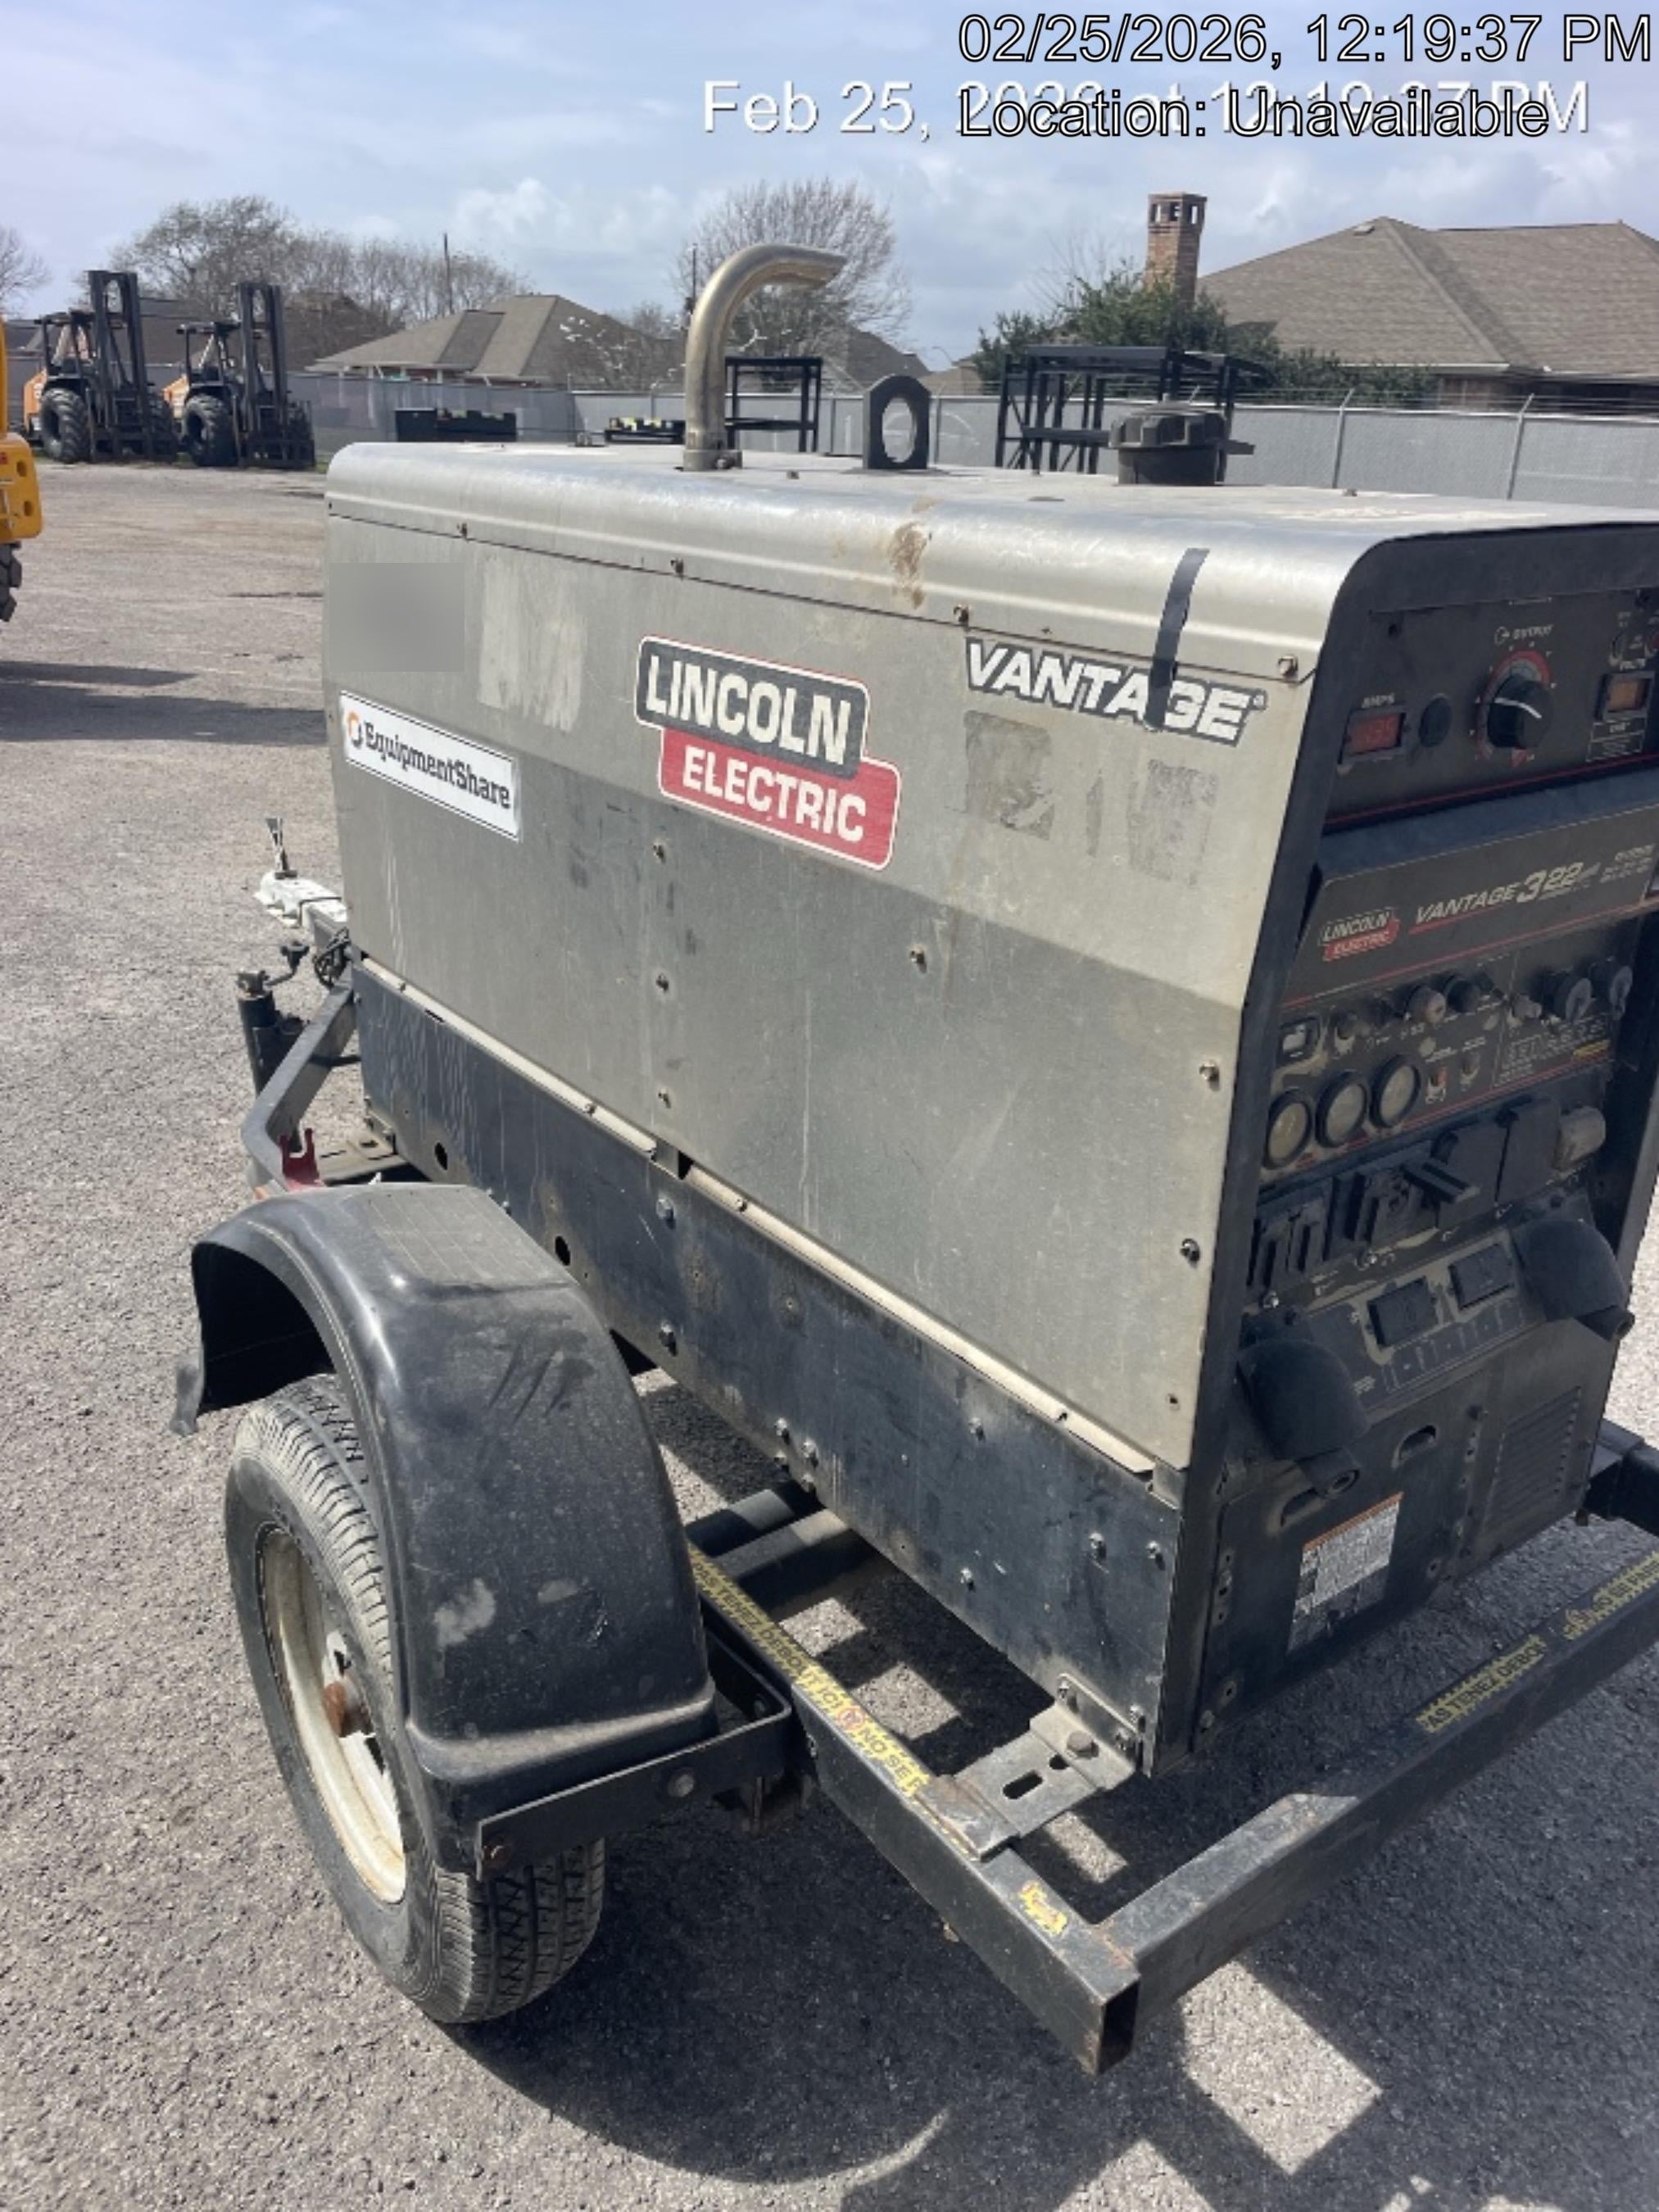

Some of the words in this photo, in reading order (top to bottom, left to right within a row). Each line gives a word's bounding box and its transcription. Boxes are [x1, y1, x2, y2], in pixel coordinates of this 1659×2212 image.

[646, 655, 852, 765] LINCOLN
[364, 719, 511, 809] EquipmentShare
[682, 745, 867, 843] ELECTRIC
[1321, 910, 1390, 942] LINCOLN
[1416, 882, 1519, 925] VANTAGE
[1333, 930, 1392, 954] ELECTRIC
